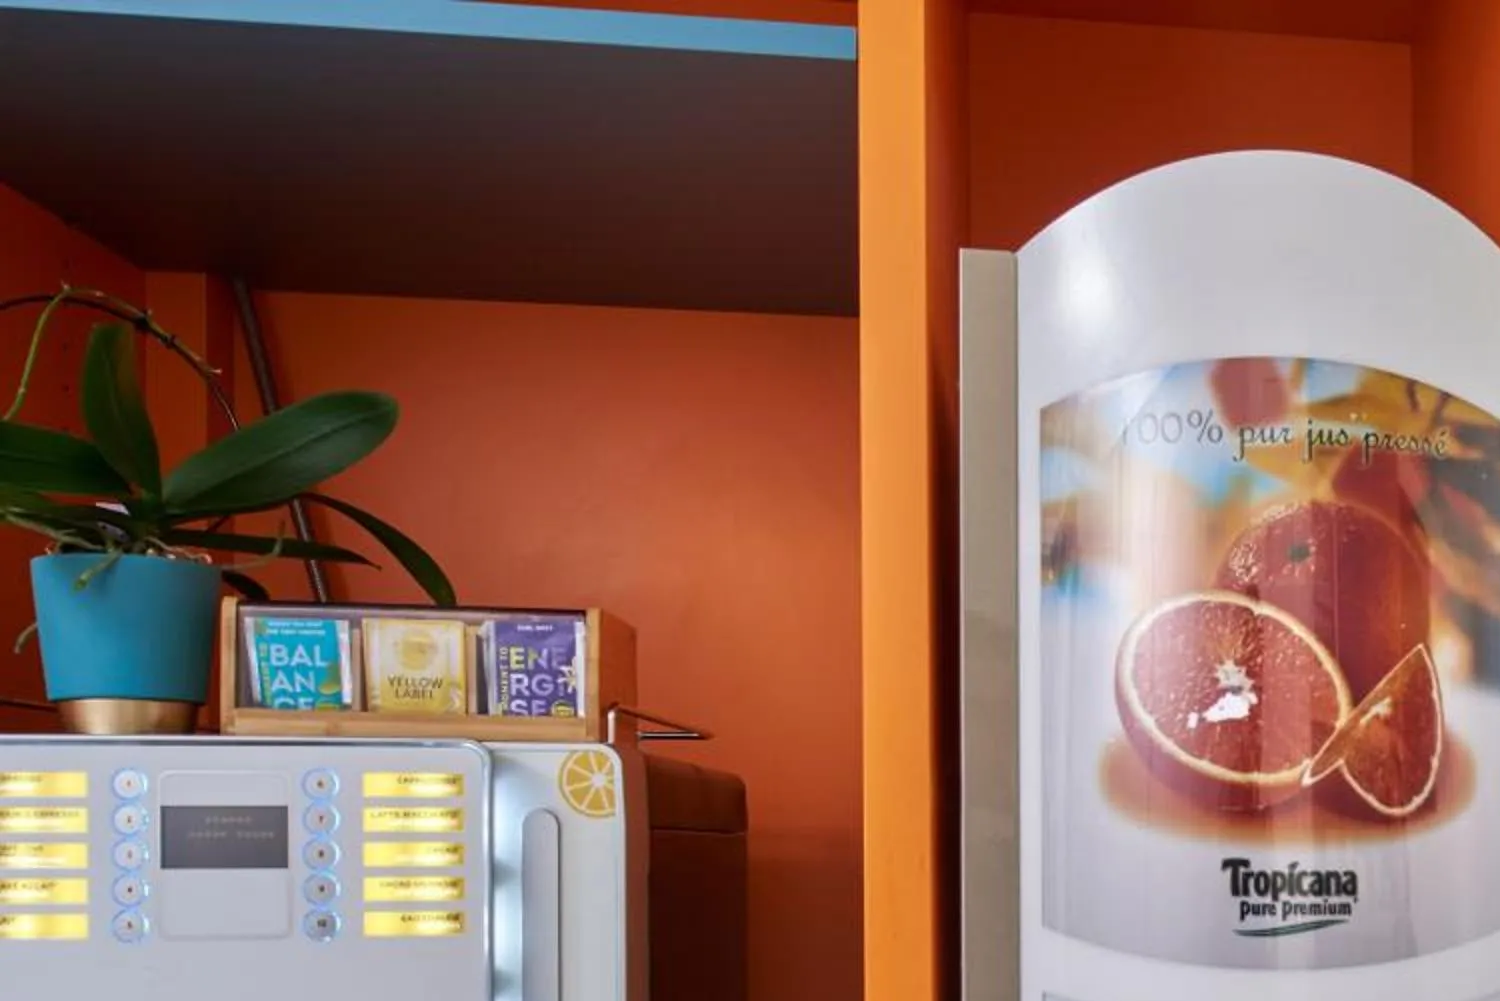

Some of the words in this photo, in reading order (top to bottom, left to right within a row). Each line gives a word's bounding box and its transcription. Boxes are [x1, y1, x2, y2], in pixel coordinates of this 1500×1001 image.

[1121, 409, 1224, 446] 100%
[1232, 422, 1292, 463] pur
[1302, 418, 1349, 463] jus
[1362, 430, 1447, 467] pressé
[269, 643, 328, 668] BAL
[509, 646, 567, 671] ENE
[271, 670, 316, 693] AN
[387, 674, 443, 689] YELLOW
[1221, 857, 1358, 902] Tropicana
